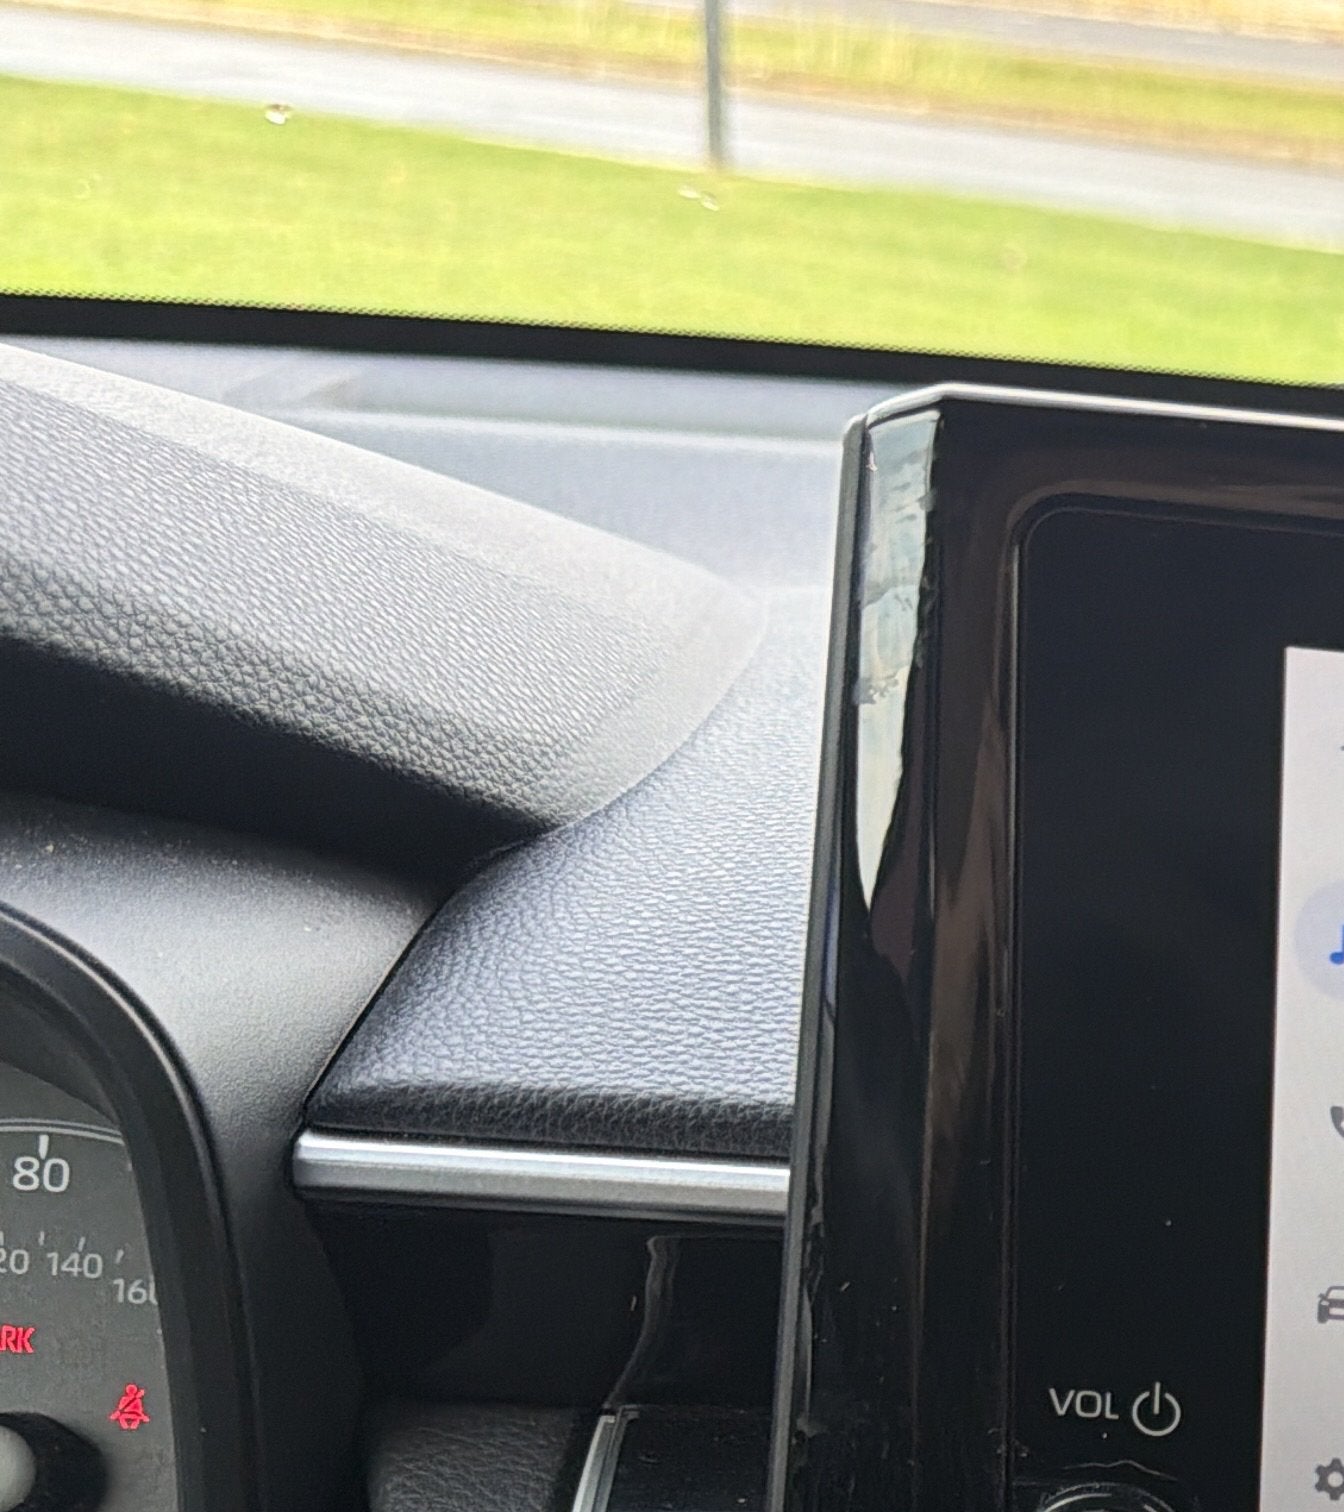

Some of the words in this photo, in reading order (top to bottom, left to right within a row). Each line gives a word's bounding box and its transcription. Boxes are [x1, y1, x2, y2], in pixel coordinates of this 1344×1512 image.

[13, 1156, 70, 1192] 80
[47, 1252, 103, 1278] 140
[0, 1324, 36, 1354] RK
[1049, 1387, 1119, 1420] VOL
